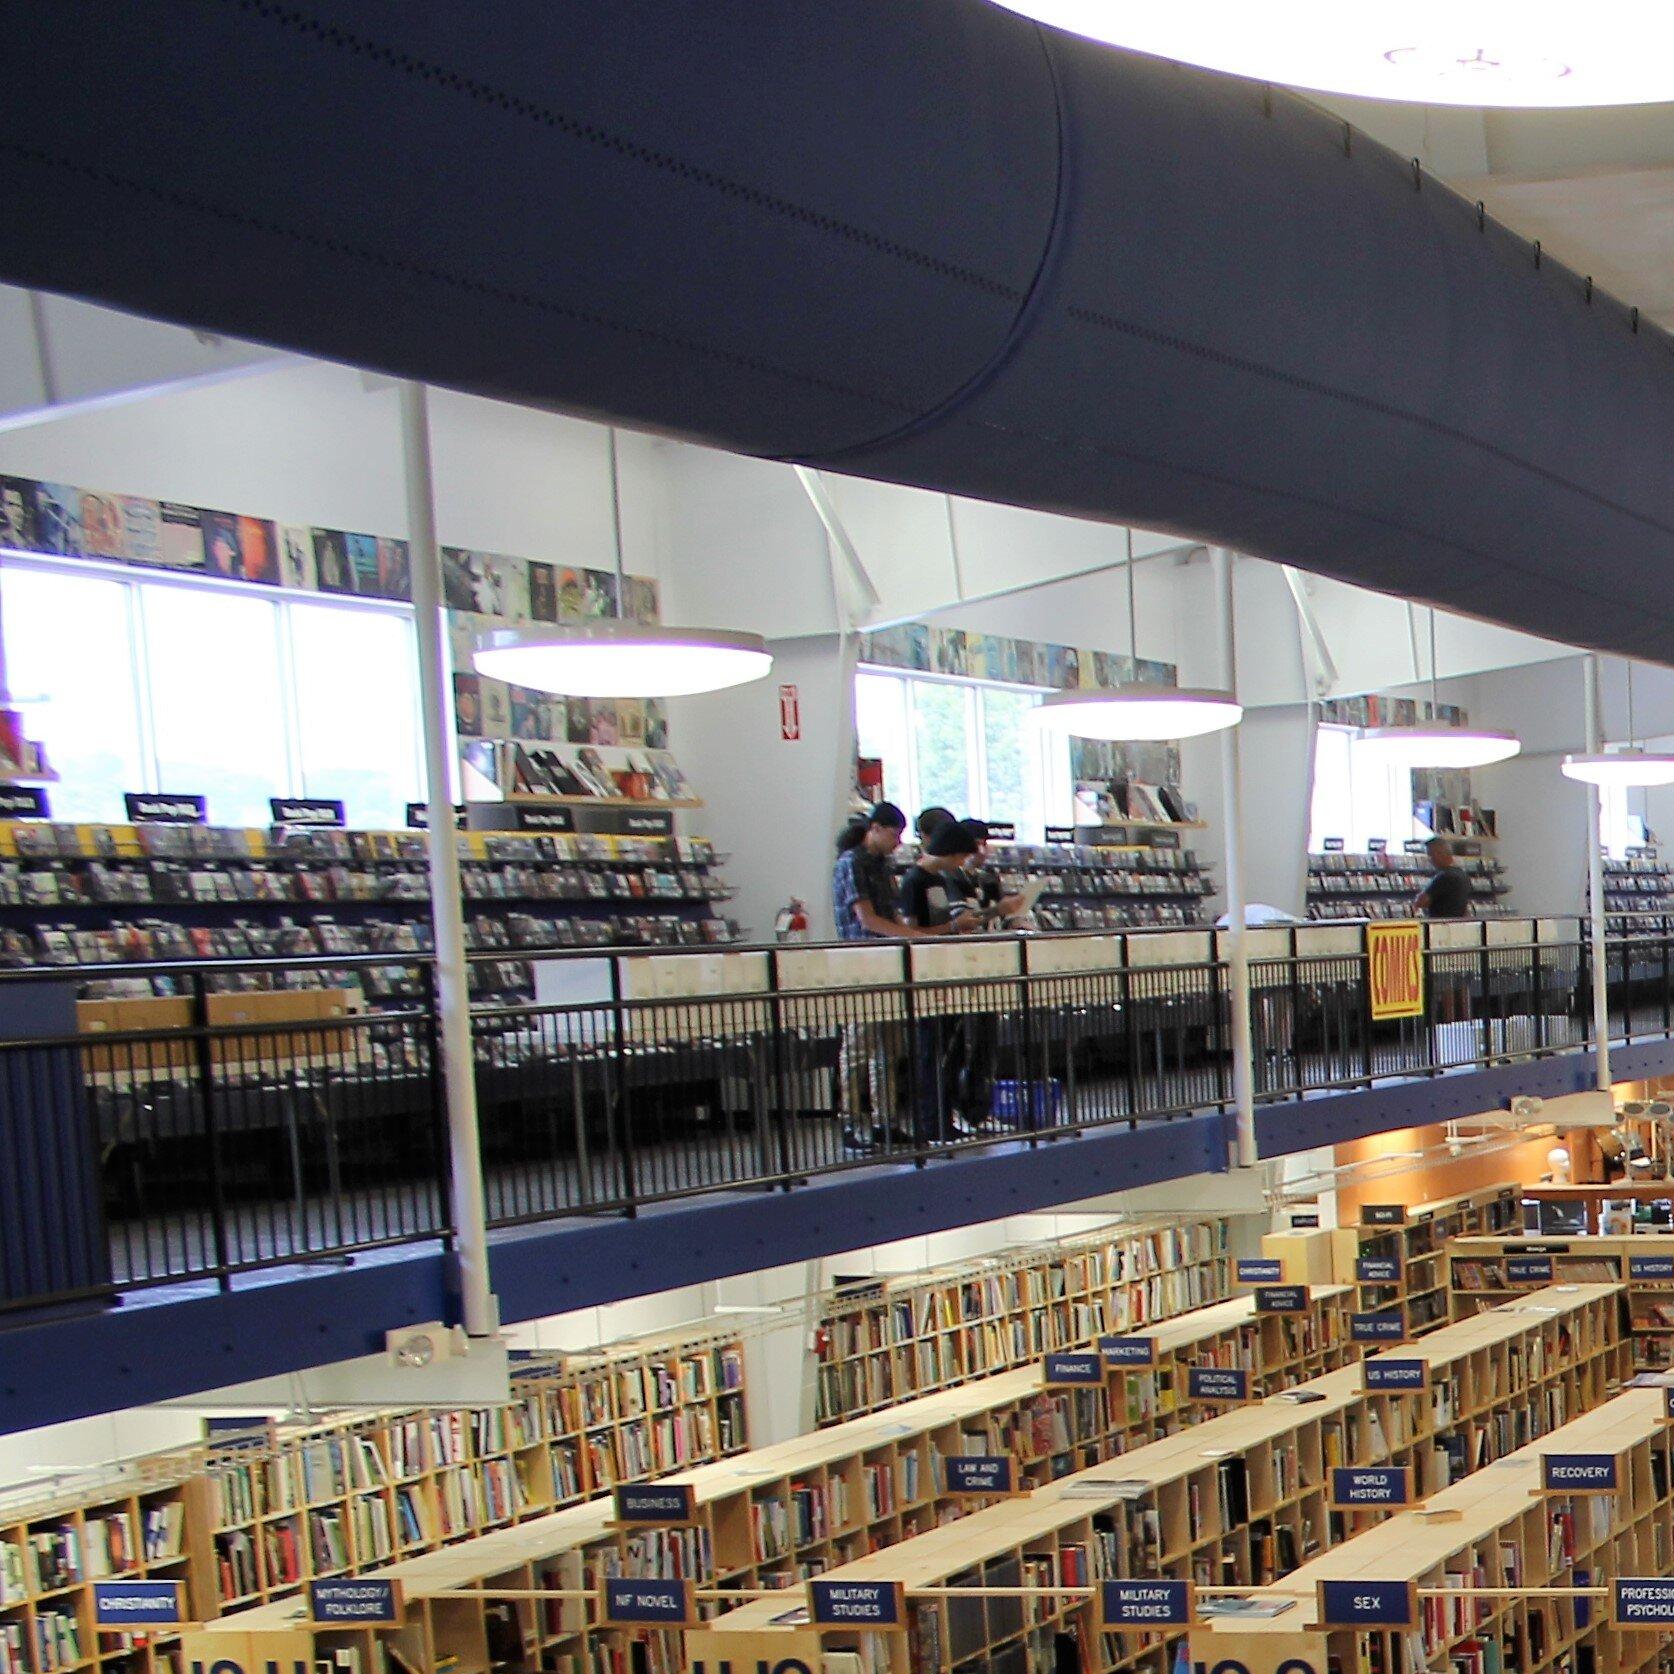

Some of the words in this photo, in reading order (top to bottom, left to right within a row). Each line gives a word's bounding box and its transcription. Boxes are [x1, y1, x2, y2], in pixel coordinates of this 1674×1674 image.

[1374, 934, 1419, 1005] COMICS
[1367, 1370, 1381, 1381] US
[1383, 1369, 1422, 1380] HISTORY
[1551, 1466, 1610, 1479] RECOVERY
[1352, 1474, 1388, 1486] WORLD
[1349, 1488, 1392, 1499] HISTORY
[315, 1587, 389, 1600] MYTHOLOGY/
[829, 1588, 879, 1601] MILITARY
[1119, 1588, 1171, 1602] MILITARY
[615, 1593, 633, 1606] NF
[636, 1594, 678, 1609] NOVEL
[1353, 1596, 1381, 1610] SEX
[325, 1602, 384, 1616] FOLKLORE
[832, 1603, 881, 1617] STUDIES
[1121, 1604, 1172, 1618] STUDIES
